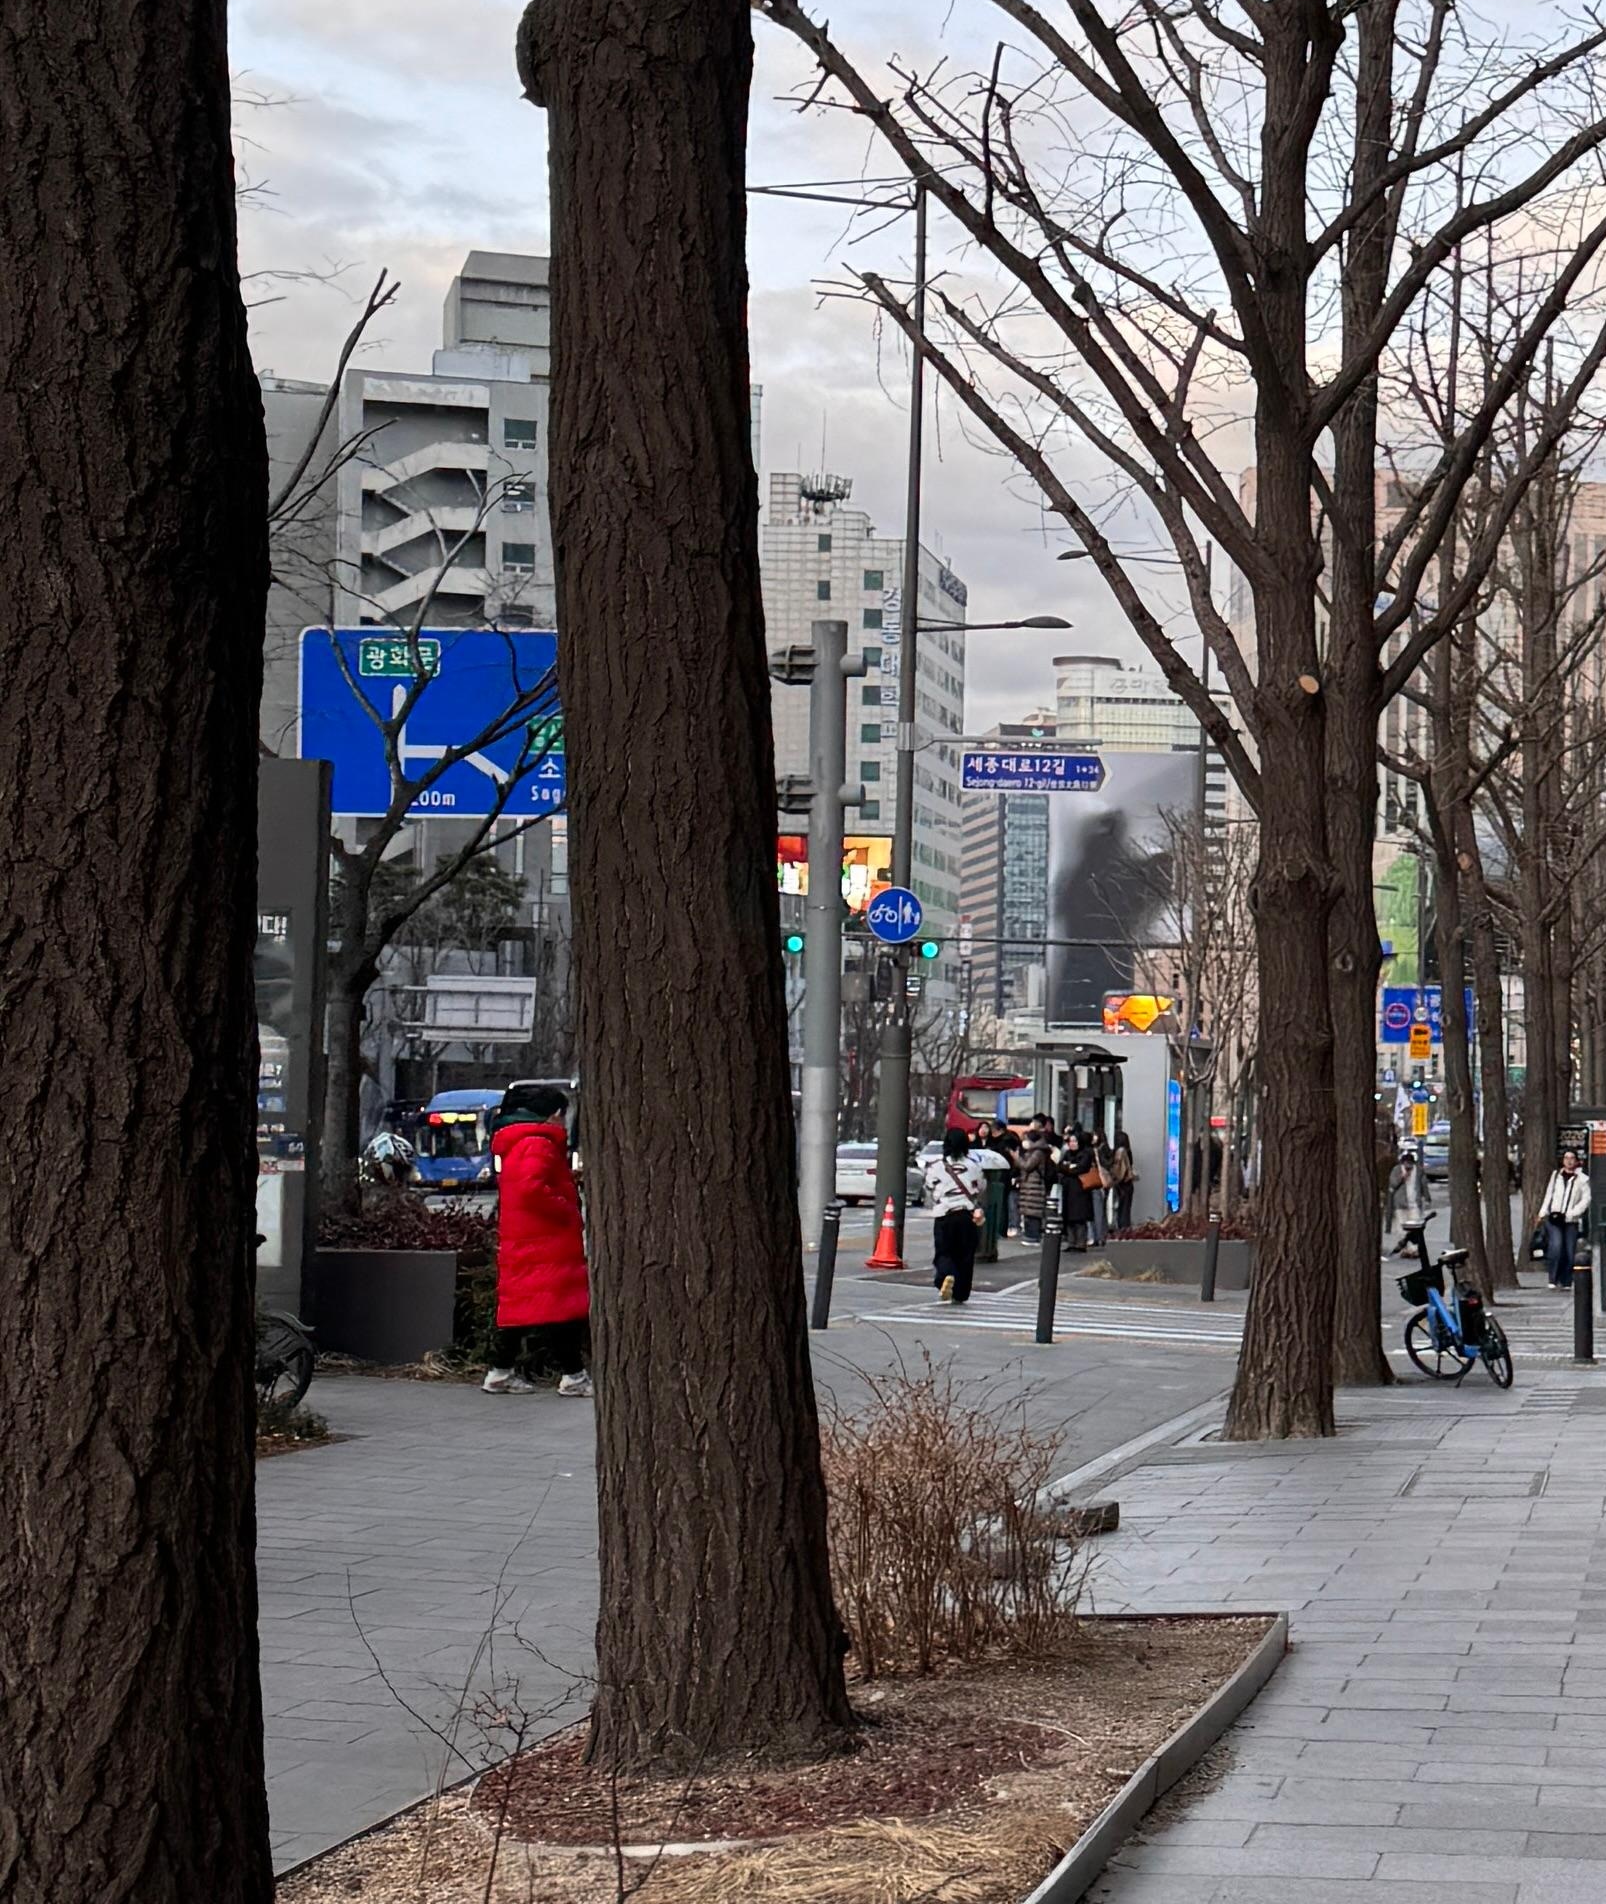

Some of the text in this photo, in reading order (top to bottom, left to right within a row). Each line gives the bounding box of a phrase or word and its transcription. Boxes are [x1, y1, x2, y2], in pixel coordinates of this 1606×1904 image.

[967, 757, 1065, 775] 세종대로12길
[410, 791, 455, 806] 00m
[531, 785, 565, 804] Sog
